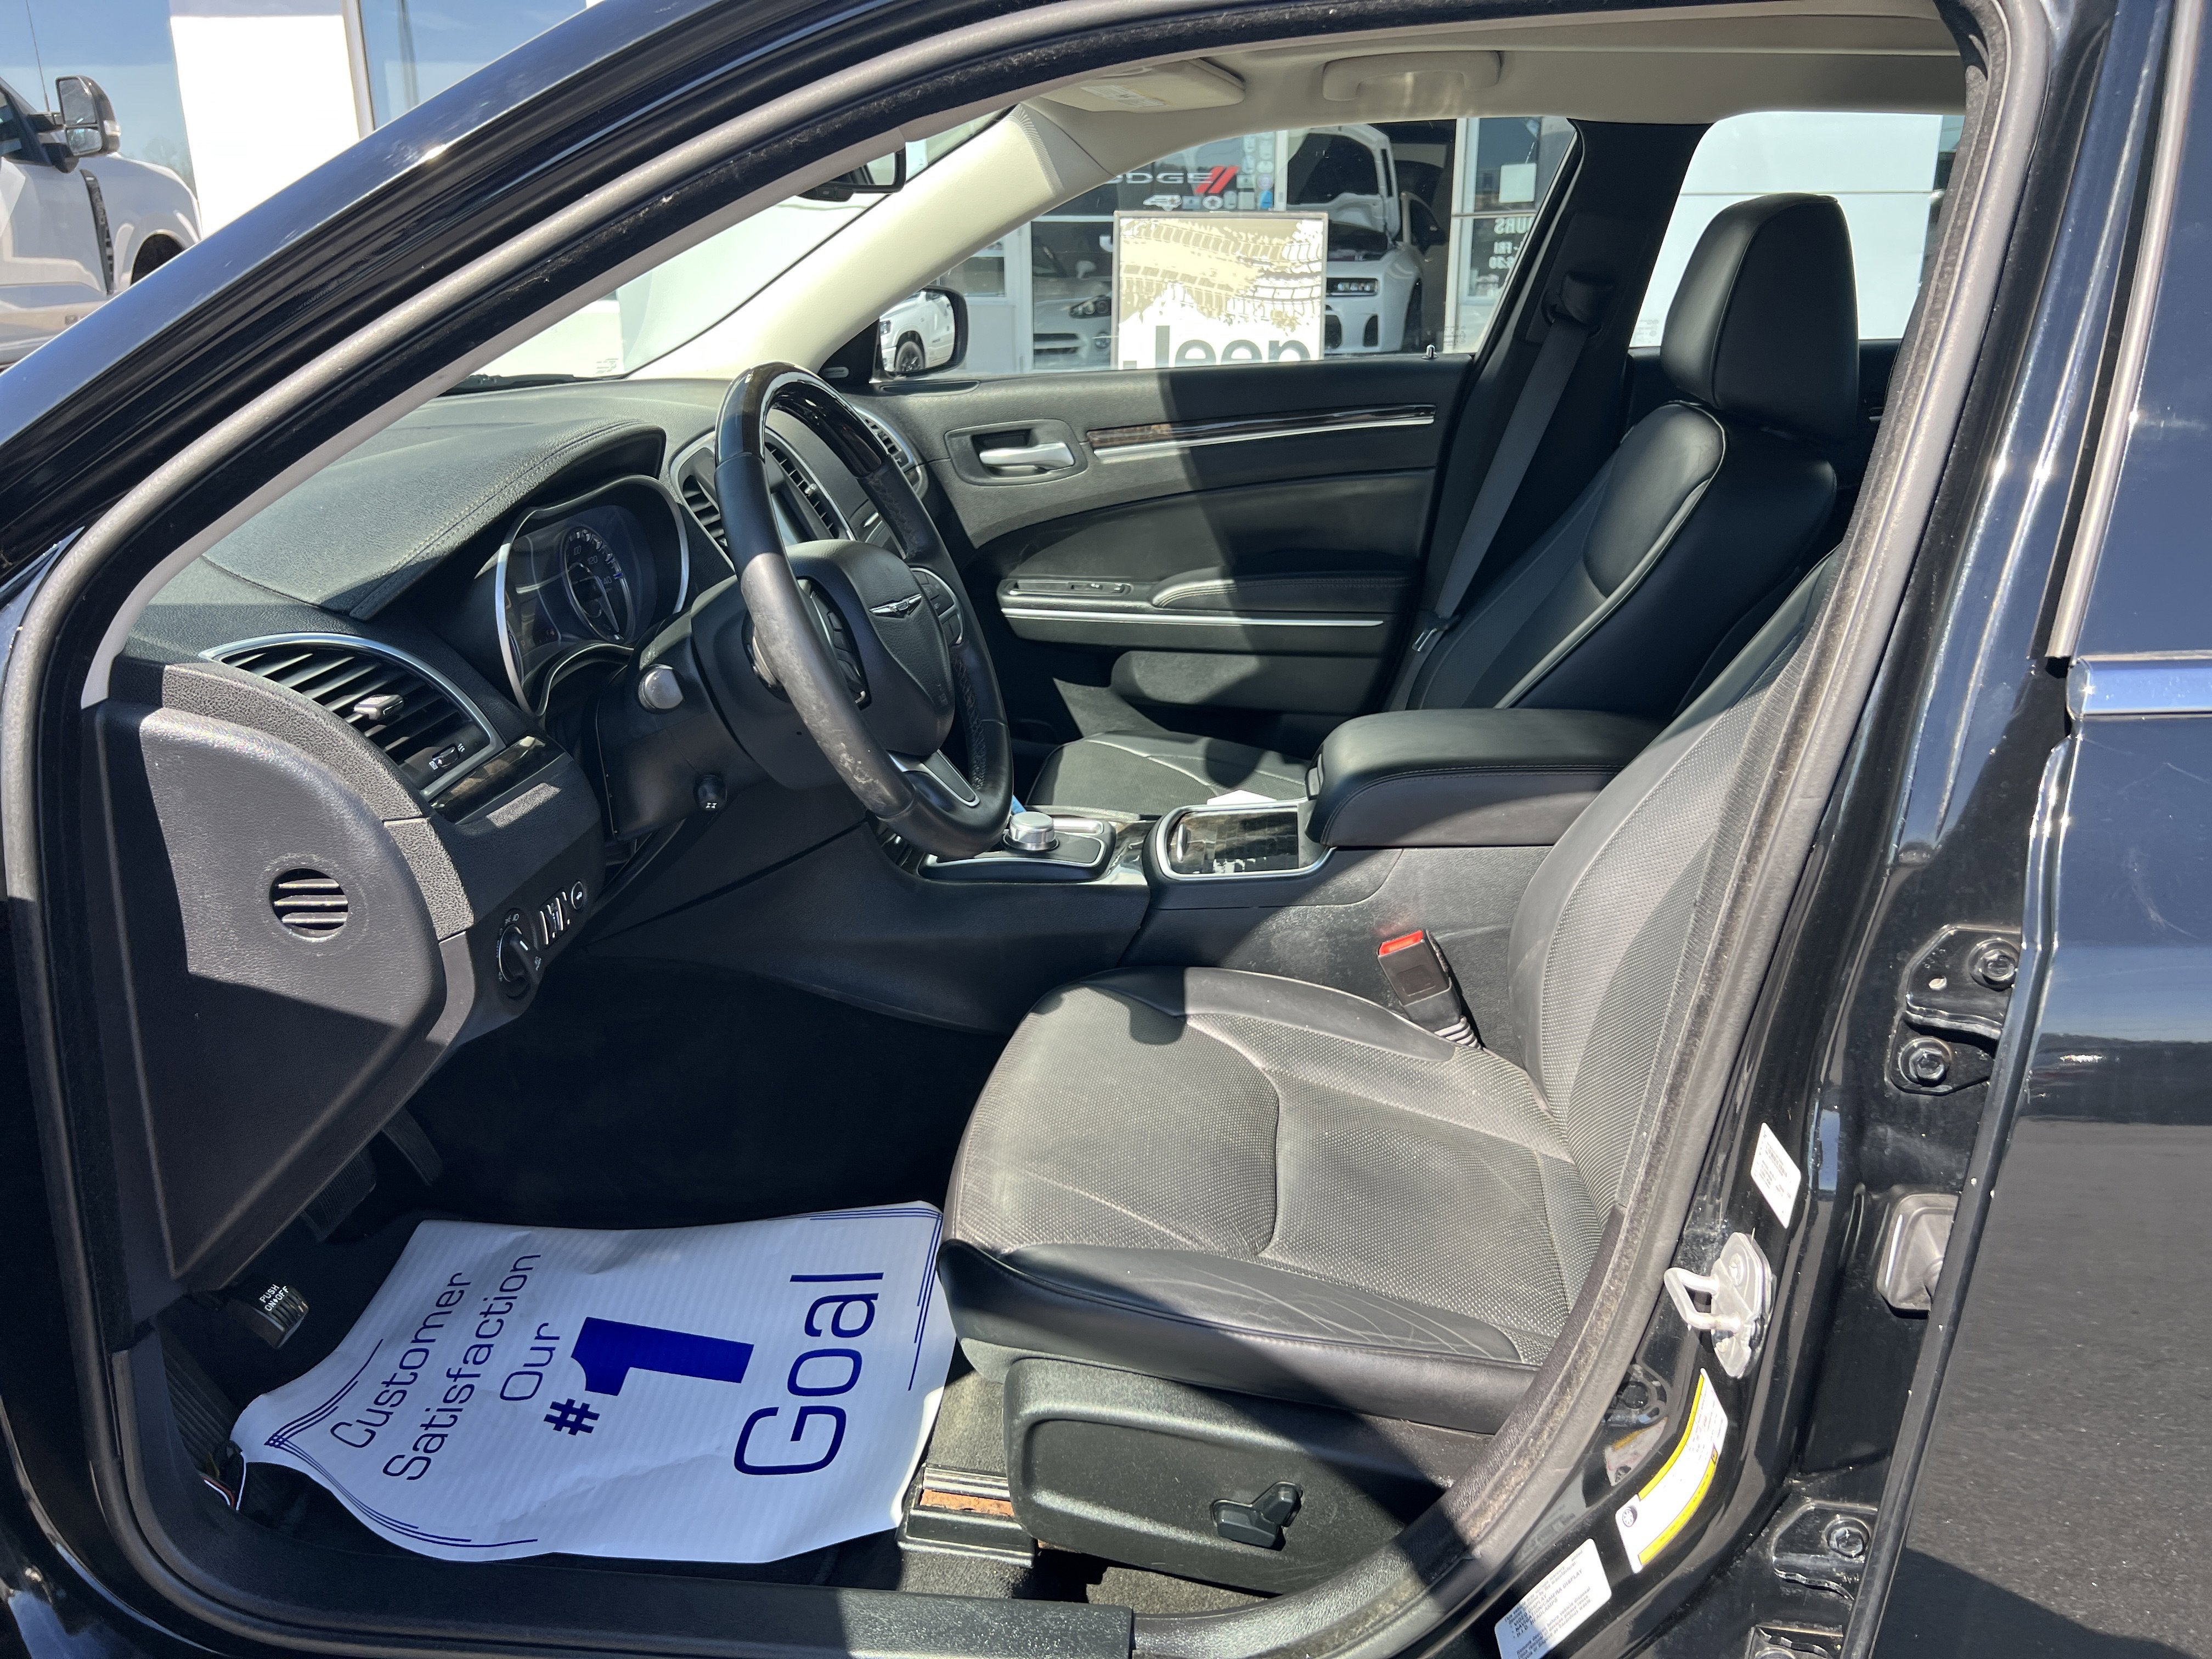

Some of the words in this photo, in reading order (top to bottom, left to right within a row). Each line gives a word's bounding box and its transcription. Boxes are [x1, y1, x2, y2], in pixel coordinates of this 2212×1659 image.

[259, 1284, 280, 1304] PUSH
[330, 1272, 471, 1448] Customer
[383, 1254, 541, 1480] Satisfaction
[499, 1323, 560, 1401] Our
[733, 1272, 884, 1475] Goal
[1514, 1611, 1527, 1626] VIDEO
[1528, 1594, 1547, 1613] DISPLAY
[1562, 1568, 1582, 1589] DISPLAY
